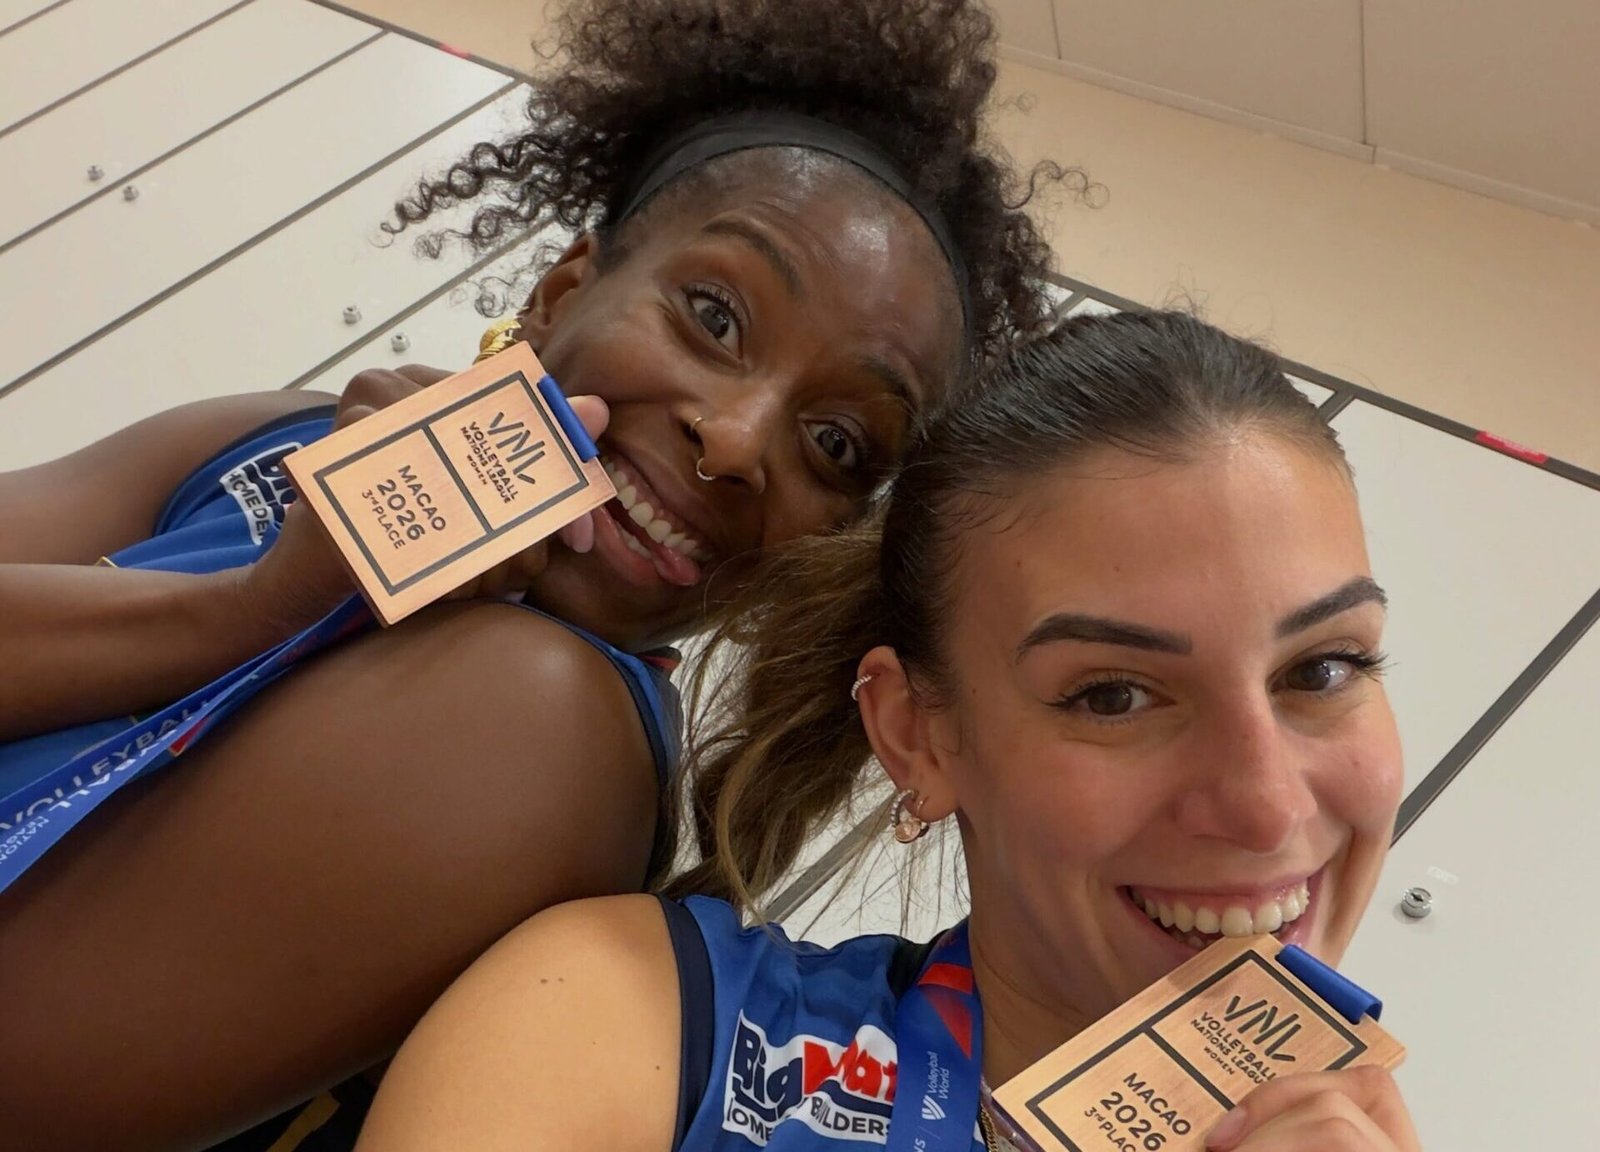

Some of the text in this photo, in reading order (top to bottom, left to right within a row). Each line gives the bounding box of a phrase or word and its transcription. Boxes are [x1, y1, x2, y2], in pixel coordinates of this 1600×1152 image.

[461, 426, 512, 504] NATIONS LEAGUE
[466, 454, 488, 486] WOMEN
[469, 421, 519, 500] VOLLEYBALL
[372, 506, 406, 550] PLACE
[376, 479, 426, 541] 2026
[398, 465, 446, 531] MACAO
[0, 817, 50, 865] NATION
[1191, 1019, 1264, 1084] NATIONS LEAGU
[1203, 1046, 1235, 1076] WOMEN
[938, 1067, 950, 1099] World
[1123, 1072, 1191, 1136] MACAO
[1098, 1121, 1137, 1152] PLAC
[1100, 1091, 1167, 1152] 2026
